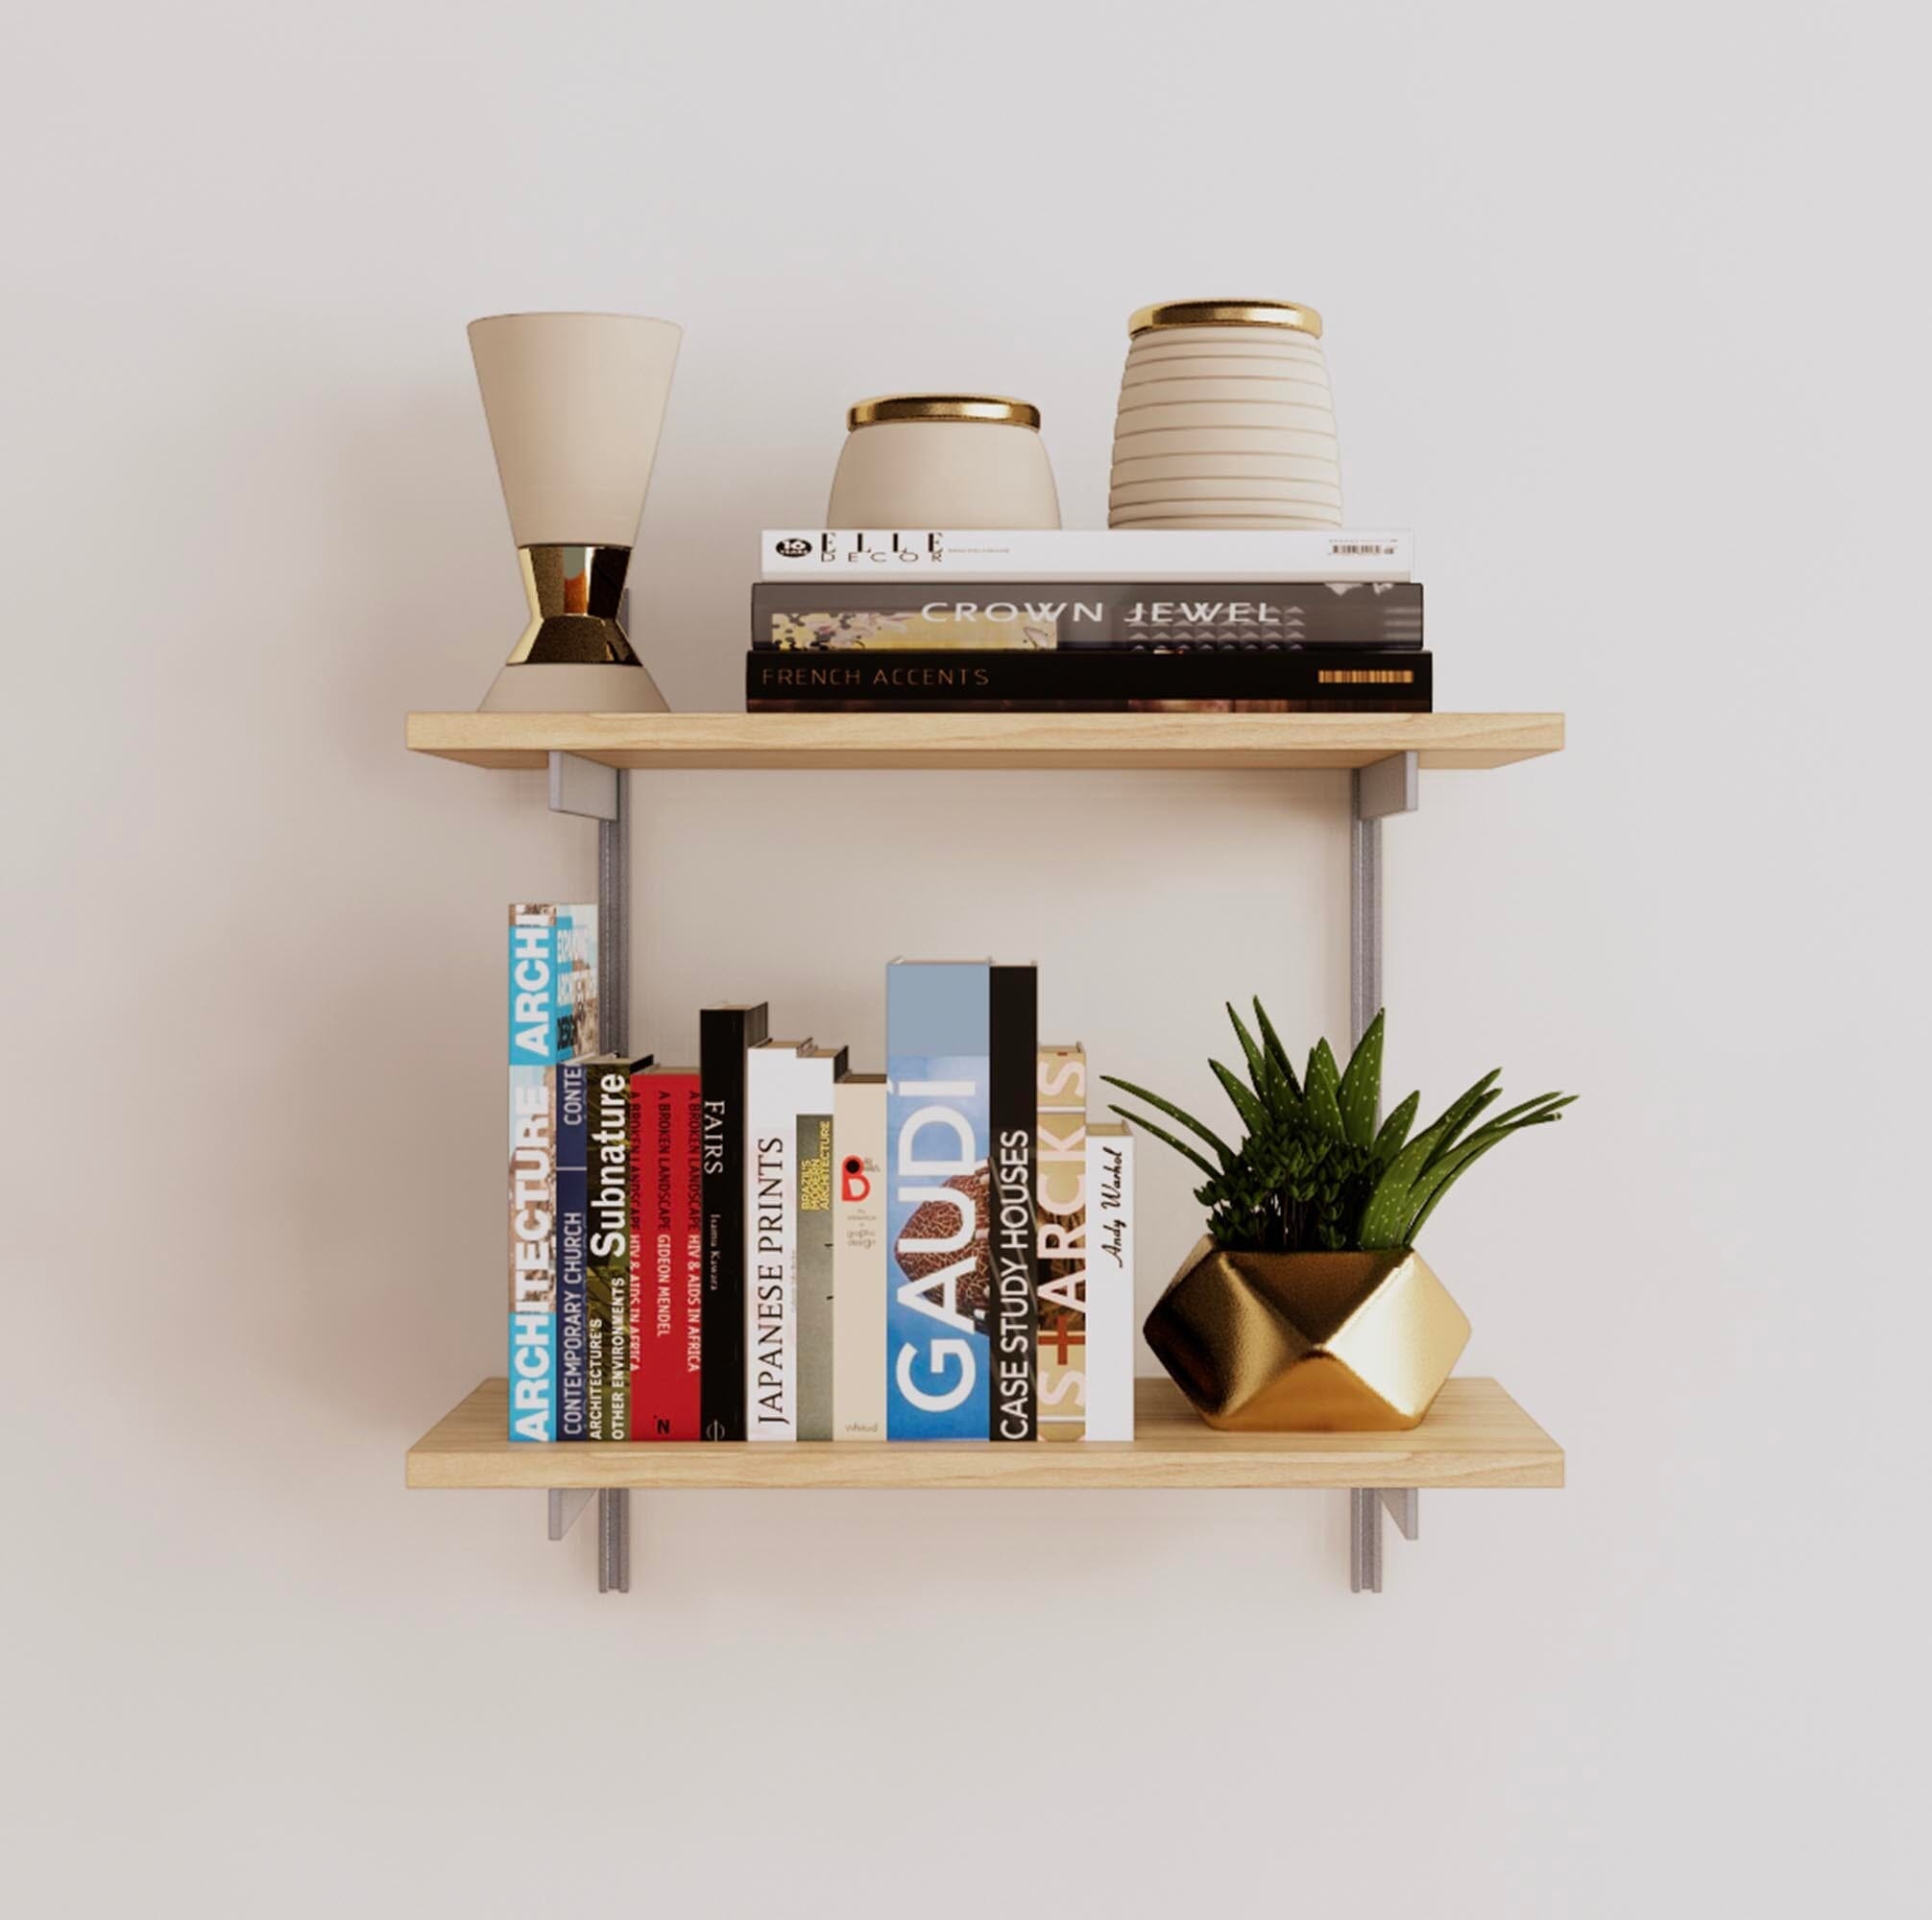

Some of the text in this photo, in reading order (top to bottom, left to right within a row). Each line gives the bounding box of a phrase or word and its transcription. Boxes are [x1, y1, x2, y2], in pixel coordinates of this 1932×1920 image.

[821, 532, 944, 554] ELLE
[821, 552, 943, 563] DECOR
[921, 602, 1281, 622] CROWN JEWEL
[762, 669, 990, 685] FRENCH ACCENTS
[515, 903, 550, 1057] ARCHI
[564, 1063, 583, 1126] CONTE
[688, 1091, 700, 1100] A
[688, 1103, 700, 1154] BROKEN
[590, 1072, 626, 1258] Subnature
[703, 1100, 725, 1174] FAIRS
[657, 1091, 670, 1337] A BROKEN LANDSCAPE GIDEON MENDEL
[688, 1158, 700, 1230] LANDSCAPE
[1100, 1146, 1126, 1268] Andy Warhol
[515, 1085, 550, 1442] ARCHITECTURE
[687, 1235, 701, 1260] HIV
[758, 1138, 790, 1426] JAPANESE PRINTS
[687, 1274, 701, 1306] AIDS
[687, 1308, 701, 1323] IN
[1000, 1130, 1029, 1440] CASE STUDY HOUSES
[564, 1212, 582, 1434] CONTEMPORARY CHURCH
[611, 1278, 625, 1440] OTHER ENVIRONMENTS
[687, 1326, 701, 1372] AFRICA
[589, 1318, 602, 1440] ARCHITECTURE'S
